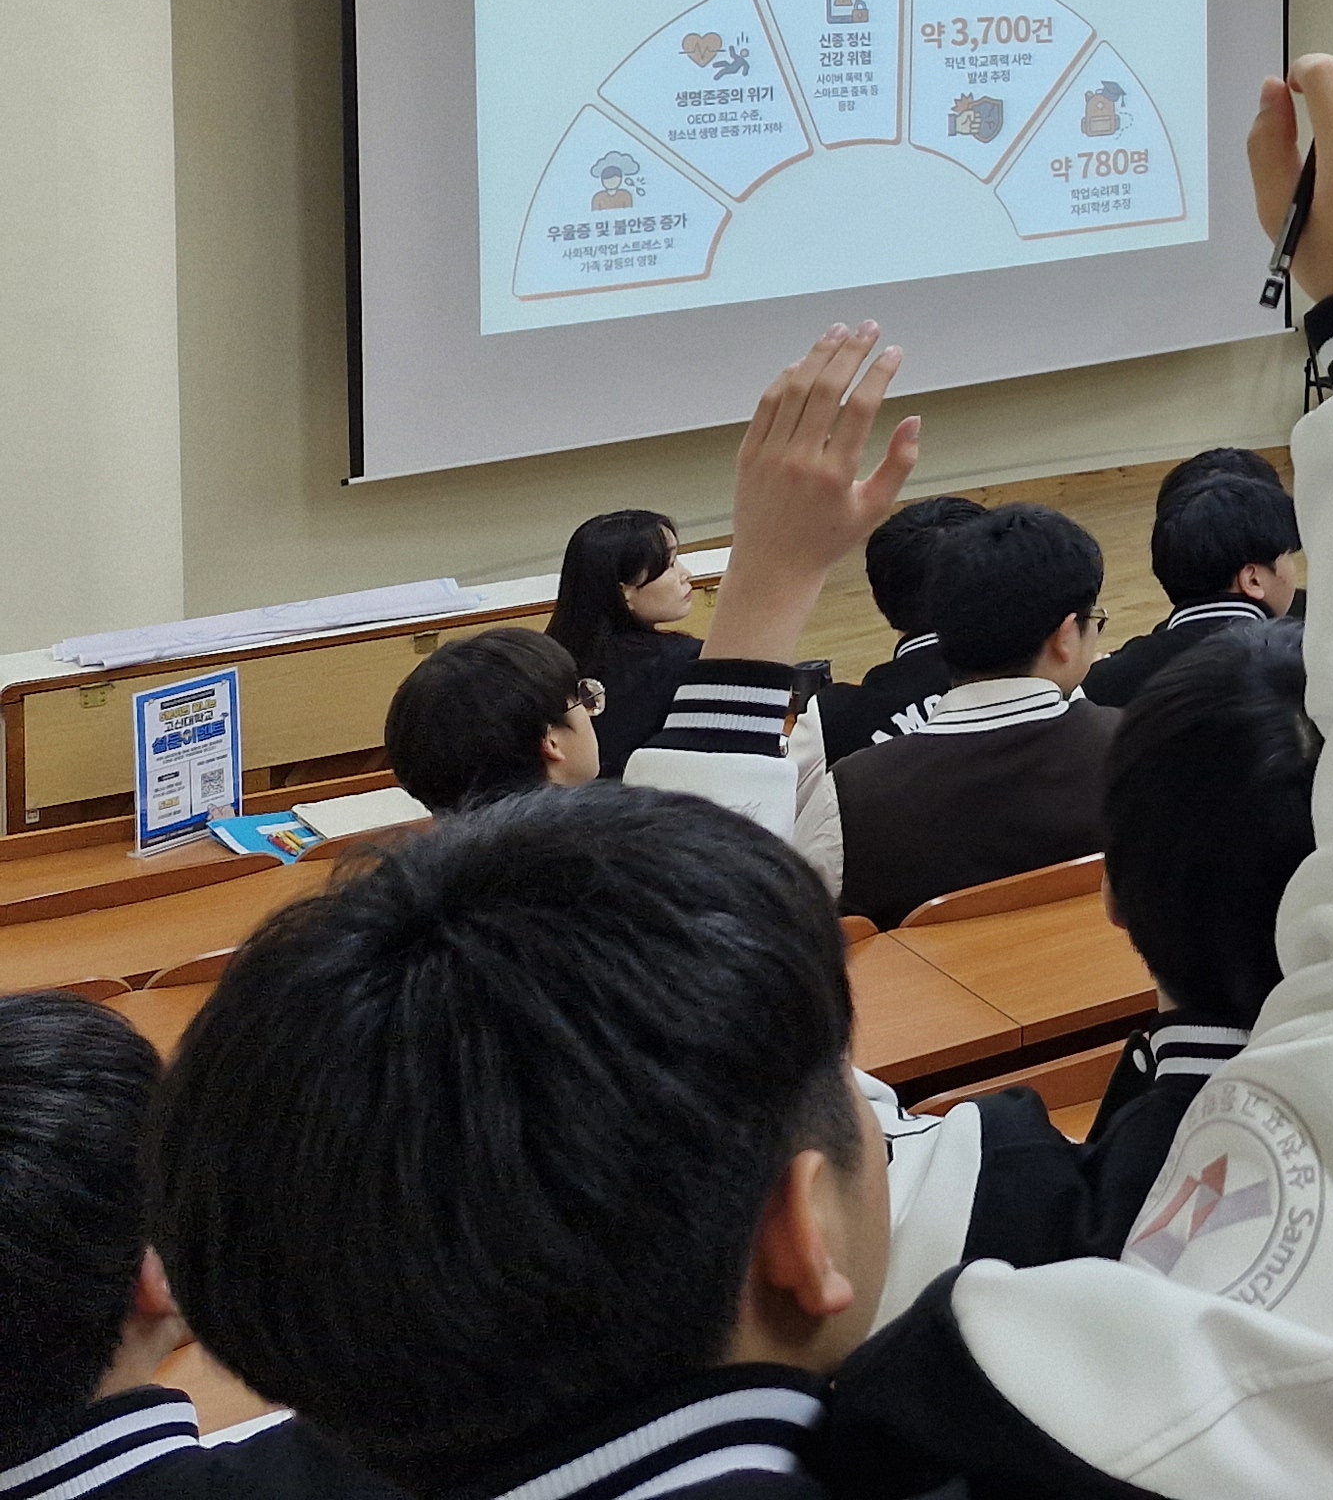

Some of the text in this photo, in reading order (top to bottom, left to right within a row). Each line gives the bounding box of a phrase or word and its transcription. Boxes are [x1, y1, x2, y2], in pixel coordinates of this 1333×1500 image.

[819, 31, 872, 48] 신종 정신
[921, 15, 1053, 52] 약 3,700건
[819, 51, 845, 67] 건강
[944, 56, 966, 70] 작년
[968, 53, 1009, 69] 학교폭력
[675, 86, 774, 108] 생명존중의 위기
[687, 113, 717, 125] OECD
[1050, 148, 1149, 183] 약 780명
[547, 213, 687, 242] 우울증 및 불안증 증가
